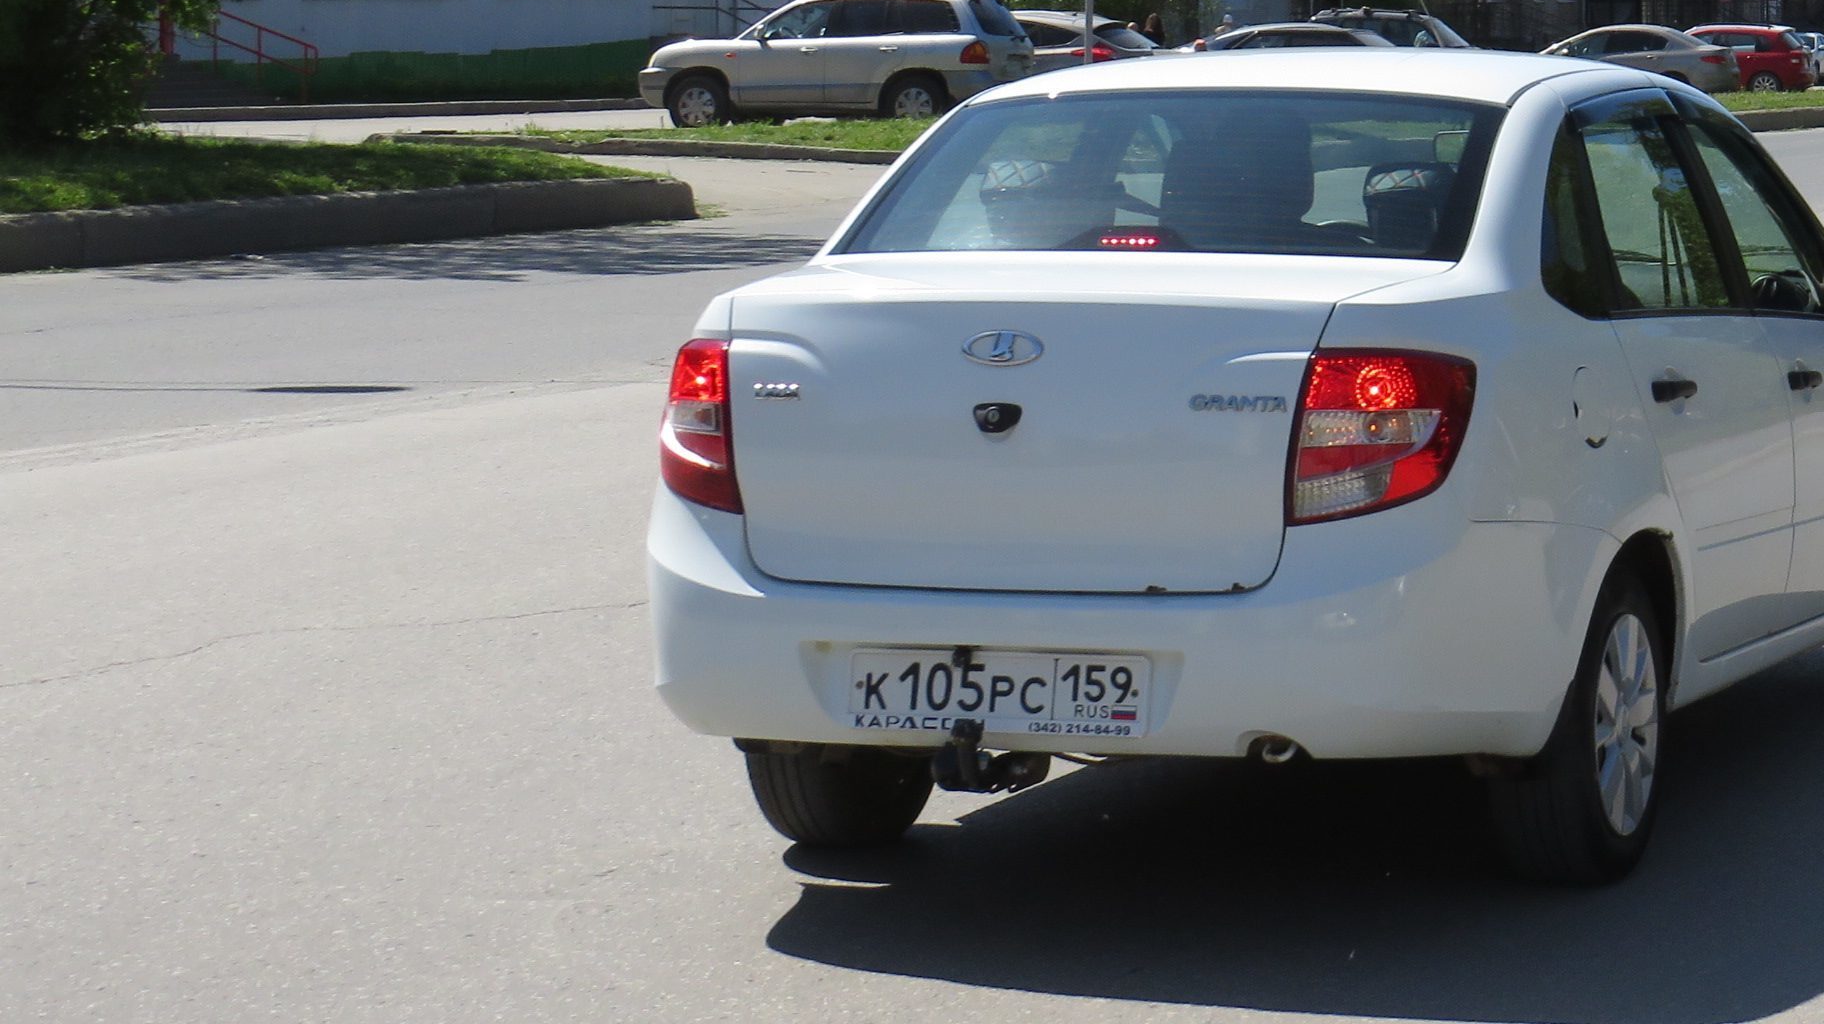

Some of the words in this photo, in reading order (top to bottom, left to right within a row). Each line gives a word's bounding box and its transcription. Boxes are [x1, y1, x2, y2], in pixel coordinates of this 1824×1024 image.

[1189, 393, 1287, 413] GRANTA
[1061, 663, 1132, 704] 159
[1074, 704, 1109, 718] RUS
[1028, 722, 1062, 733] (342)
